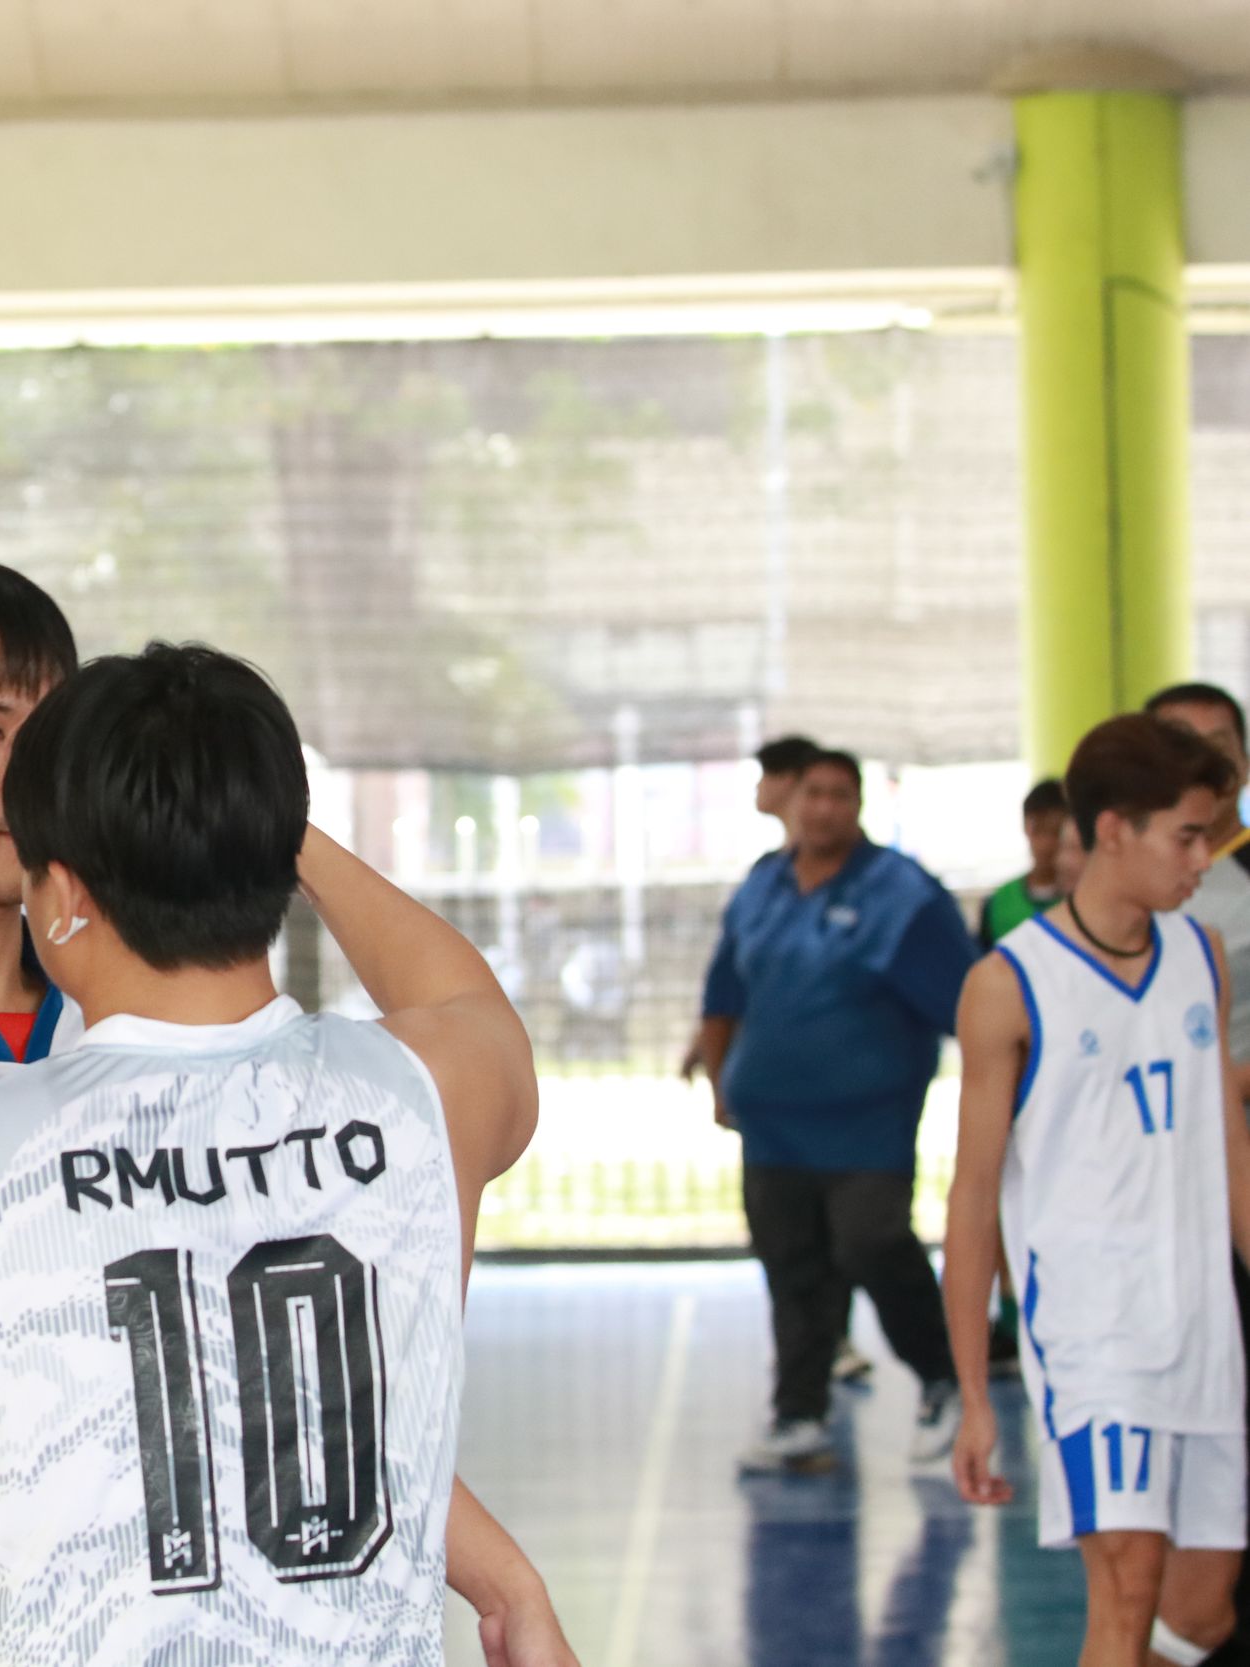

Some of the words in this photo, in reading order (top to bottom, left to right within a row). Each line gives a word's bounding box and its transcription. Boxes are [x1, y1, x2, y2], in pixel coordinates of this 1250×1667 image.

[1123, 1060, 1174, 1135] 17
[60, 1120, 386, 1213] RMUTTO
[104, 1233, 394, 1596] 10
[1101, 1421, 1150, 1492] 17
